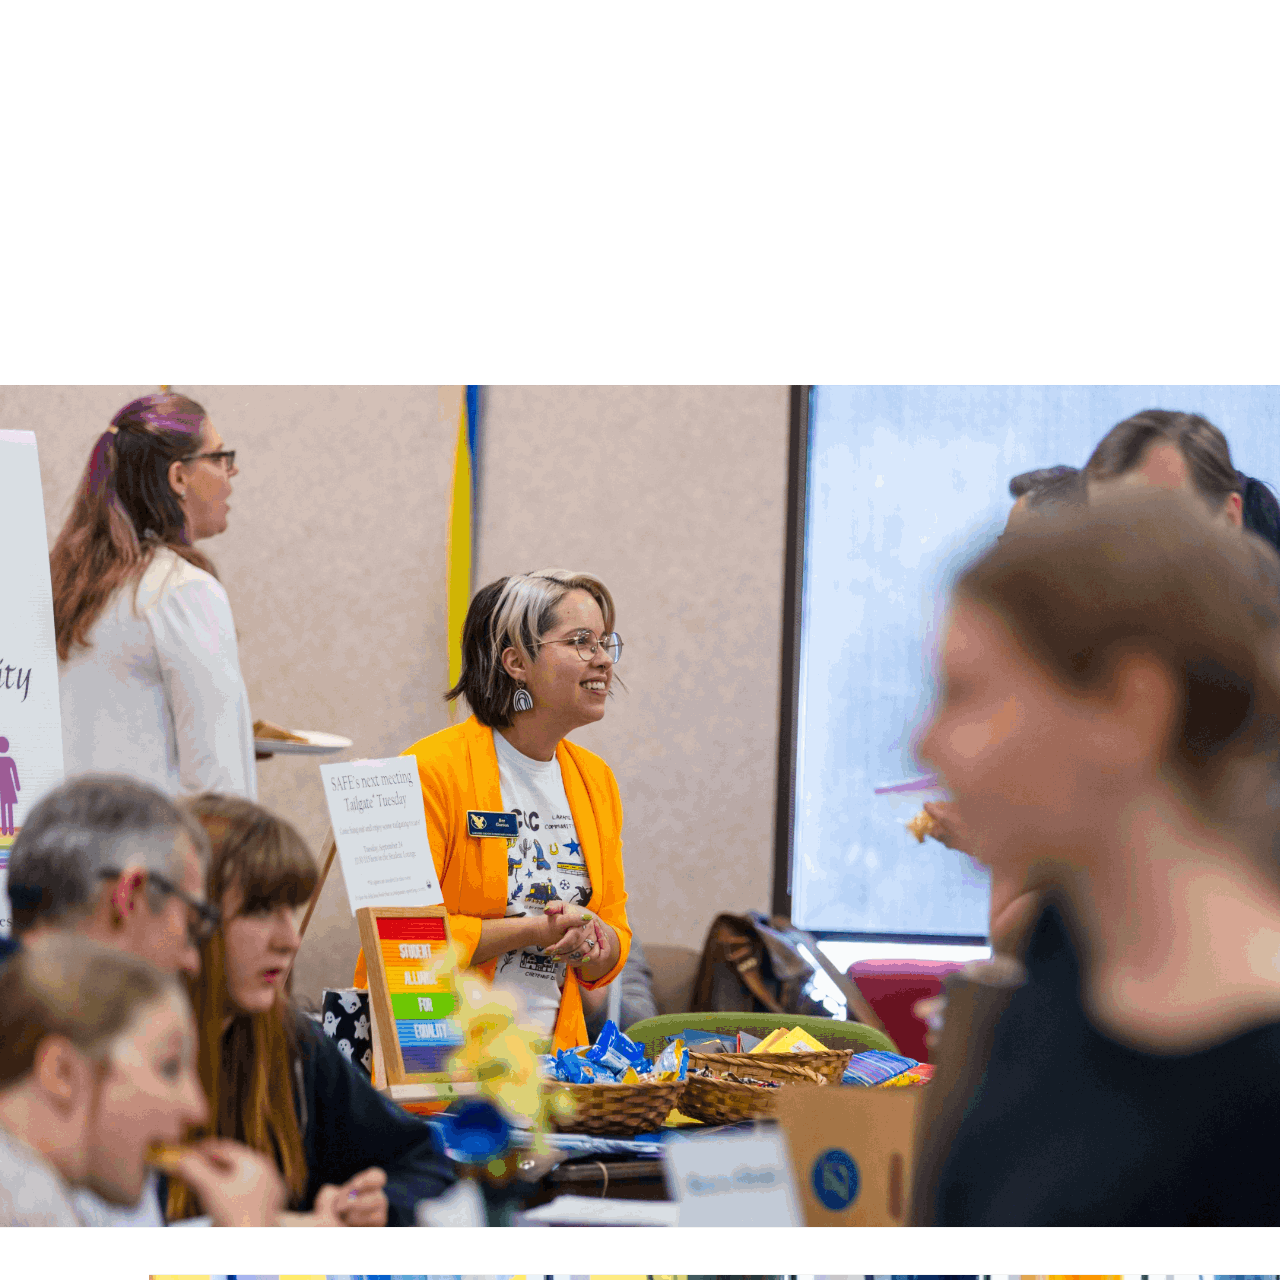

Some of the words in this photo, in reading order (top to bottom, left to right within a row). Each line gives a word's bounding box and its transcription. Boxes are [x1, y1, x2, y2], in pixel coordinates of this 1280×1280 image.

[330, 774, 360, 792] SAFE's
[361, 774, 380, 789] next
[380, 769, 414, 788] meeting
[376, 790, 407, 809] Tuesday
[398, 943, 432, 959] STUDENT
[417, 997, 434, 1012] FOR
[413, 1023, 447, 1039] EQUALITY
